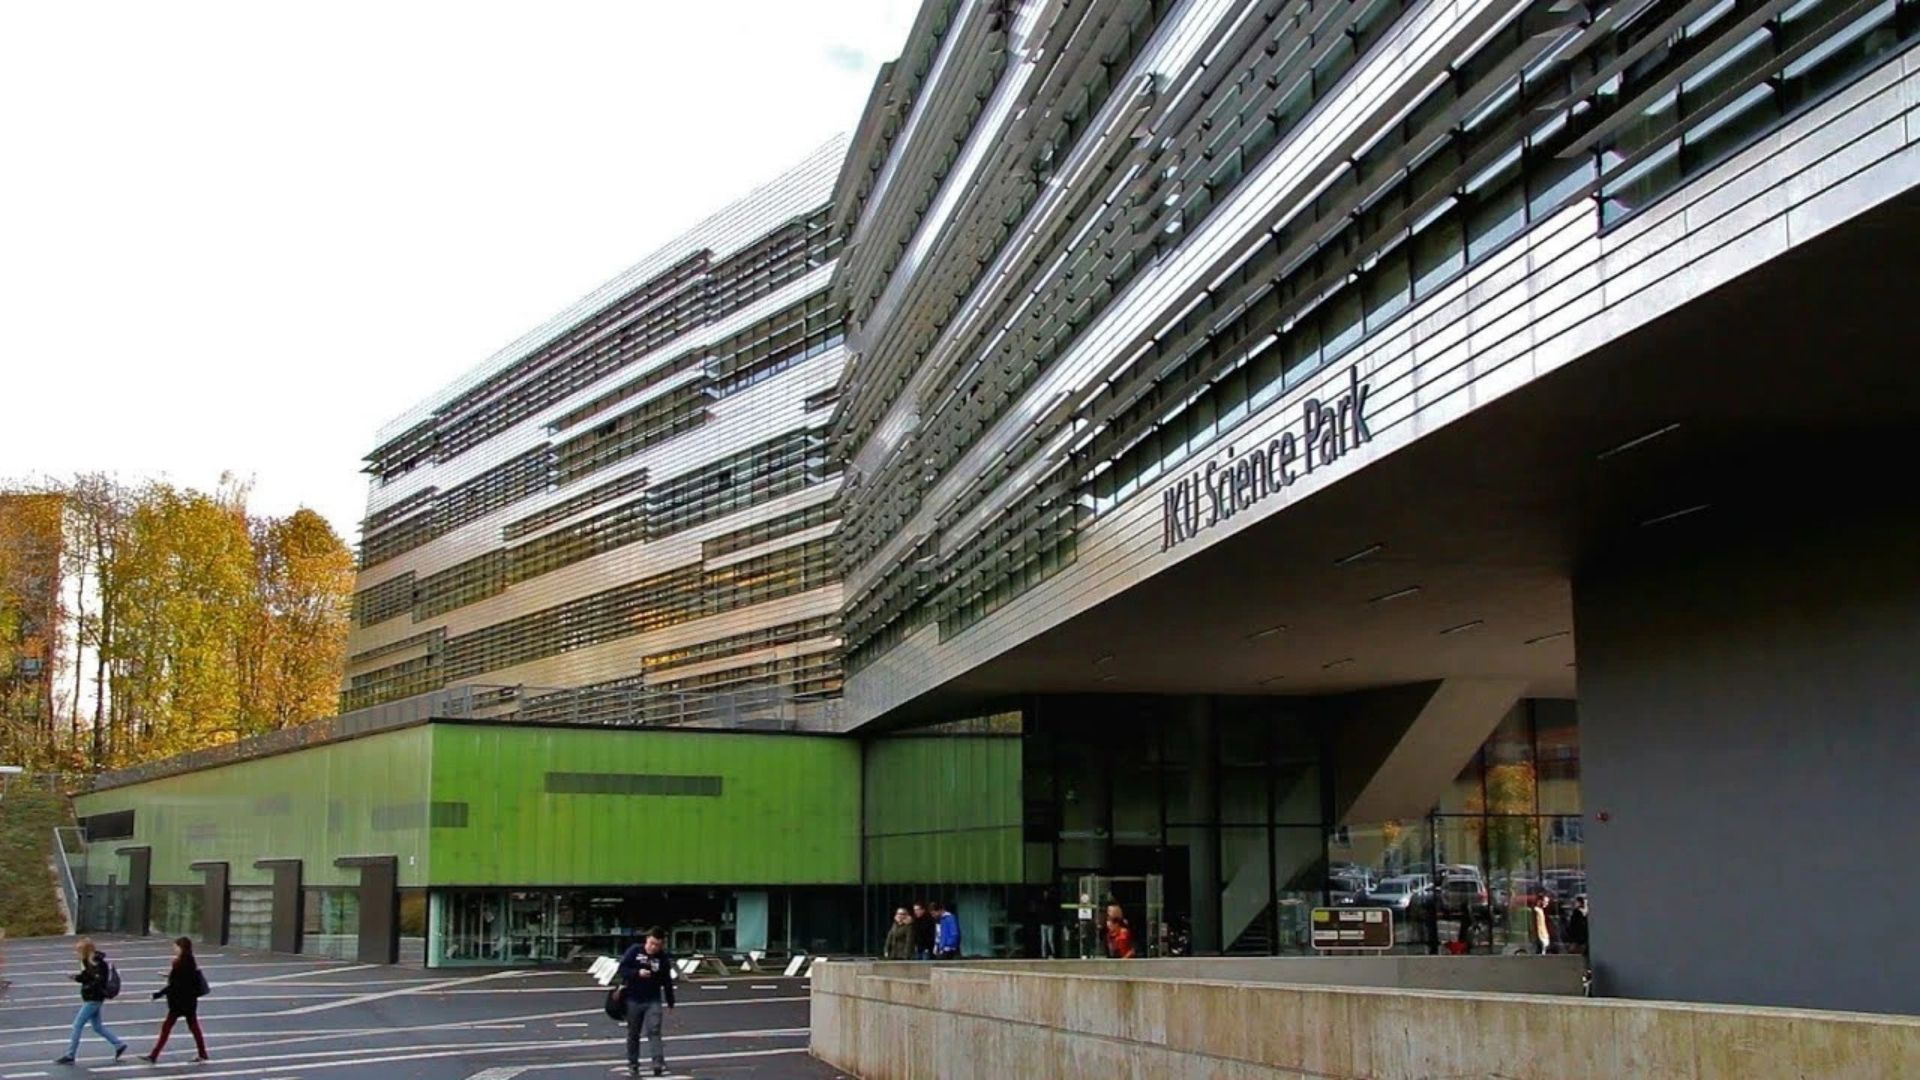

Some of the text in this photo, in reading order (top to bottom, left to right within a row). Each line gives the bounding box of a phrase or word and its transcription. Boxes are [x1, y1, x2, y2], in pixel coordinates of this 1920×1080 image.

[1161, 364, 1372, 552] JKU Science Park
